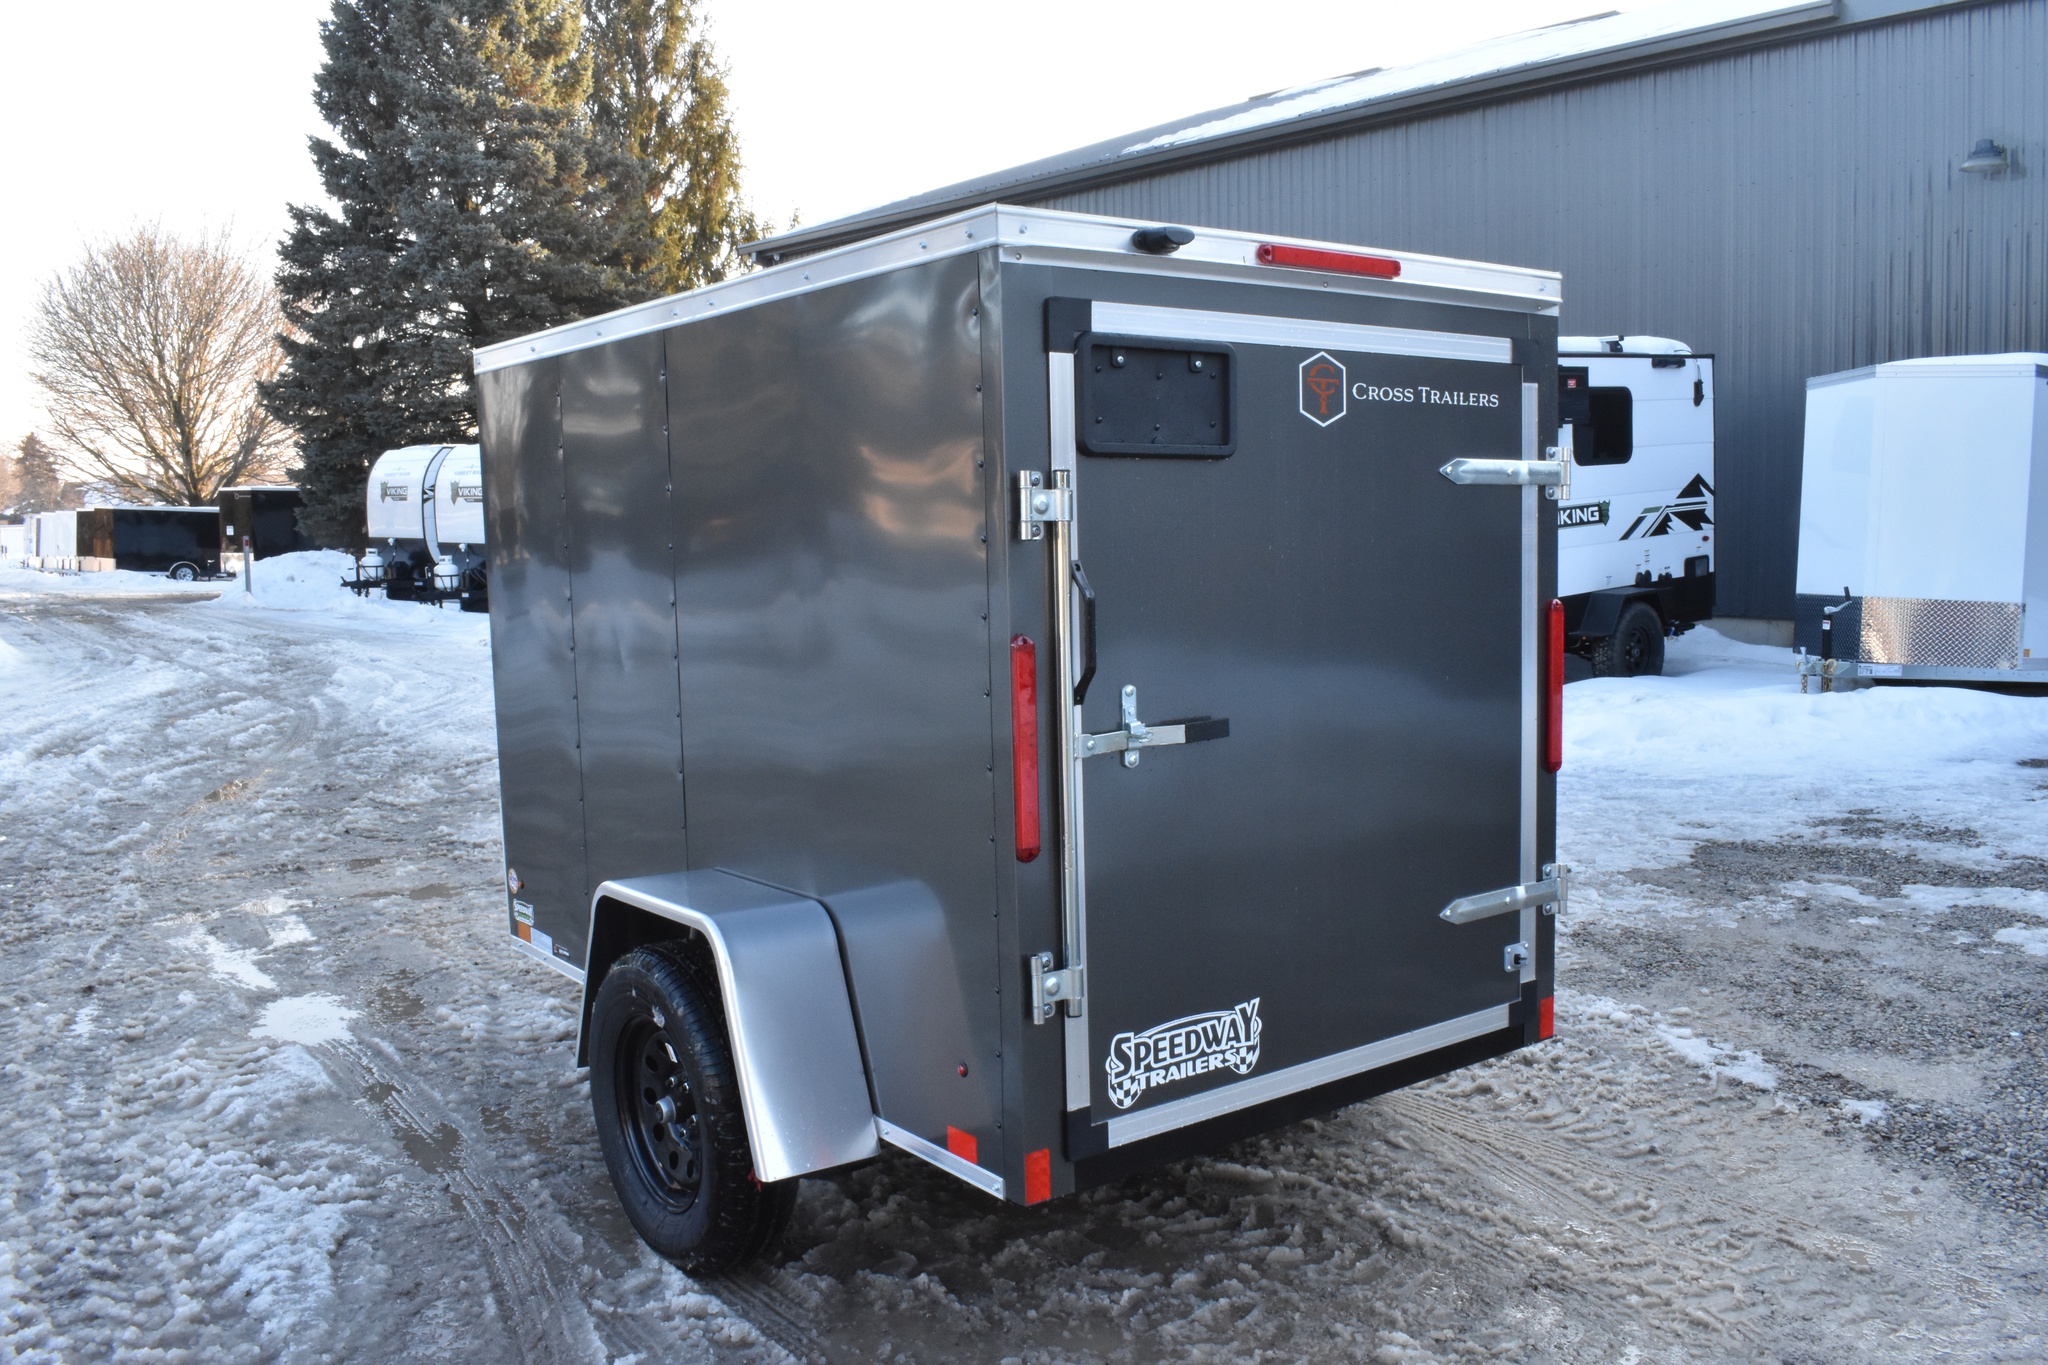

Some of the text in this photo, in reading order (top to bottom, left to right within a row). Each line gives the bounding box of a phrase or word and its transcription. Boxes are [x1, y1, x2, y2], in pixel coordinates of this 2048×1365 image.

[1352, 382, 1499, 407] CROSS TRAILERS
[386, 487, 408, 496] VIKING
[1110, 997, 1260, 1085] SPEEDWAY
[1135, 1048, 1238, 1091] TRAILERS
